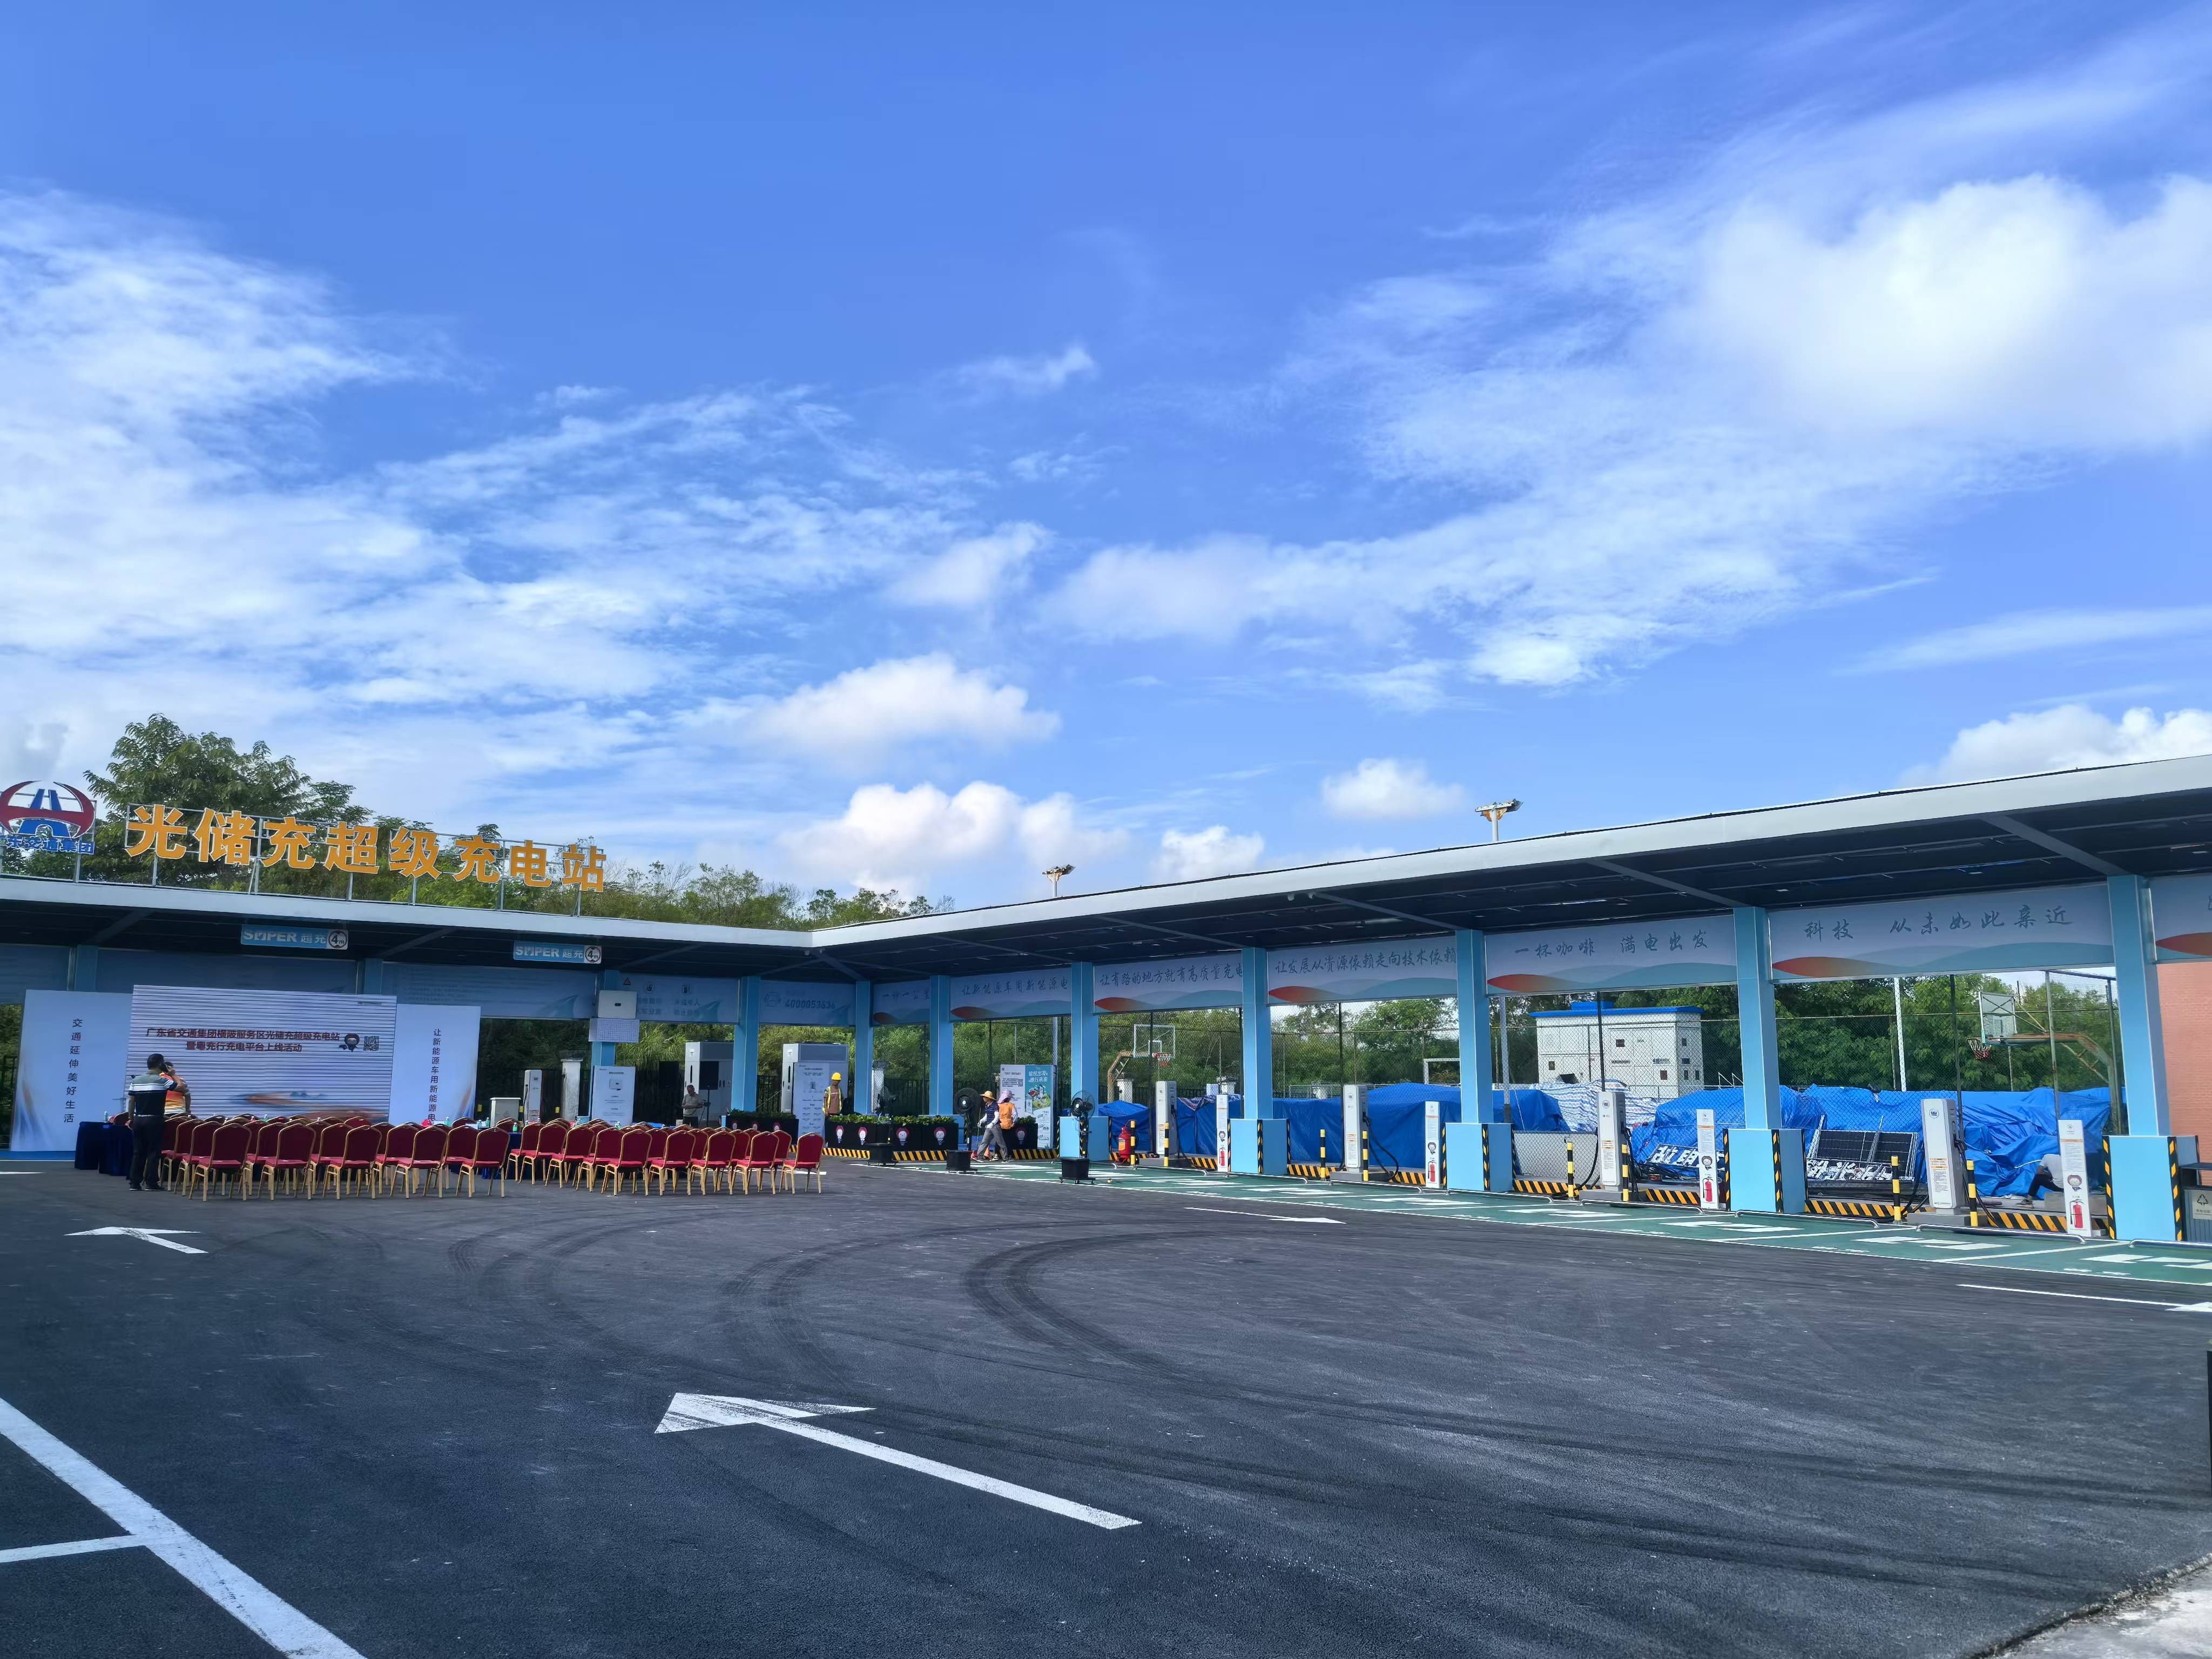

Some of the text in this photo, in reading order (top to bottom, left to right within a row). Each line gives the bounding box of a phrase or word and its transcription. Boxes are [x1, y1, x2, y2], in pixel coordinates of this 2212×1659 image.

[0, 835, 95, 854] 东交通集团
[125, 804, 606, 893] 光储充超级充电站
[1515, 929, 1708, 959] 一杯咖啡 满电出发
[1804, 919, 1853, 942] 科技
[1275, 947, 1456, 975] 让发展从资源依赖走向技术依赖
[64, 1019, 83, 1123] 交通延伸美好生活
[428, 1028, 441, 1122] 让新能源车用新能源电
